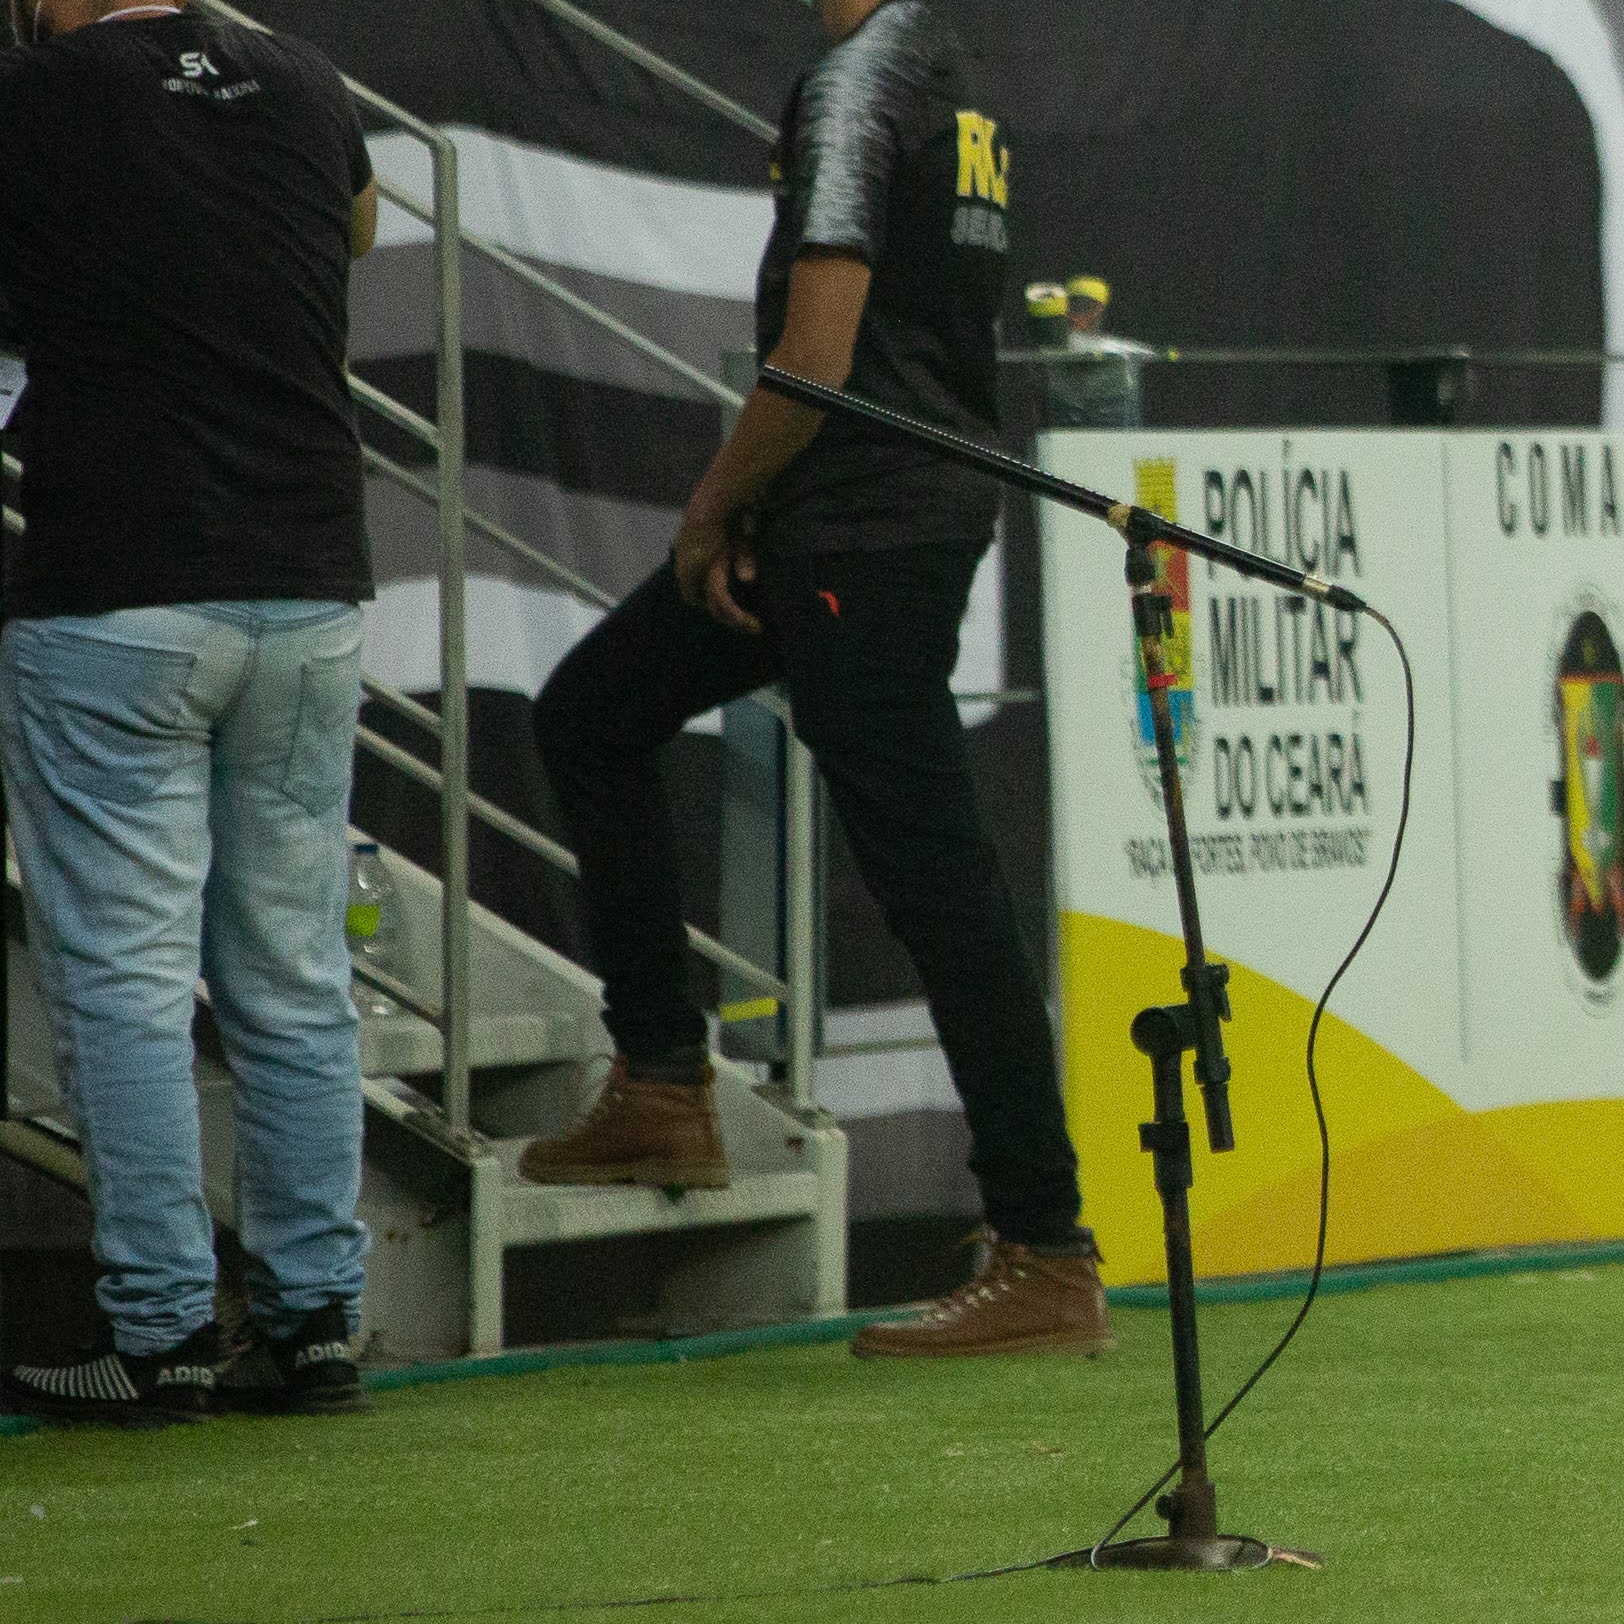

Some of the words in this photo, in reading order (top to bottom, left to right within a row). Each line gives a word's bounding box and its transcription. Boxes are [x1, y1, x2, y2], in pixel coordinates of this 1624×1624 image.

[1203, 439, 1362, 580] POLÍCIA
[1207, 593, 1363, 707] MILITAR
[1213, 734, 1255, 820] DO
[1265, 709, 1370, 818] CEARÁ
